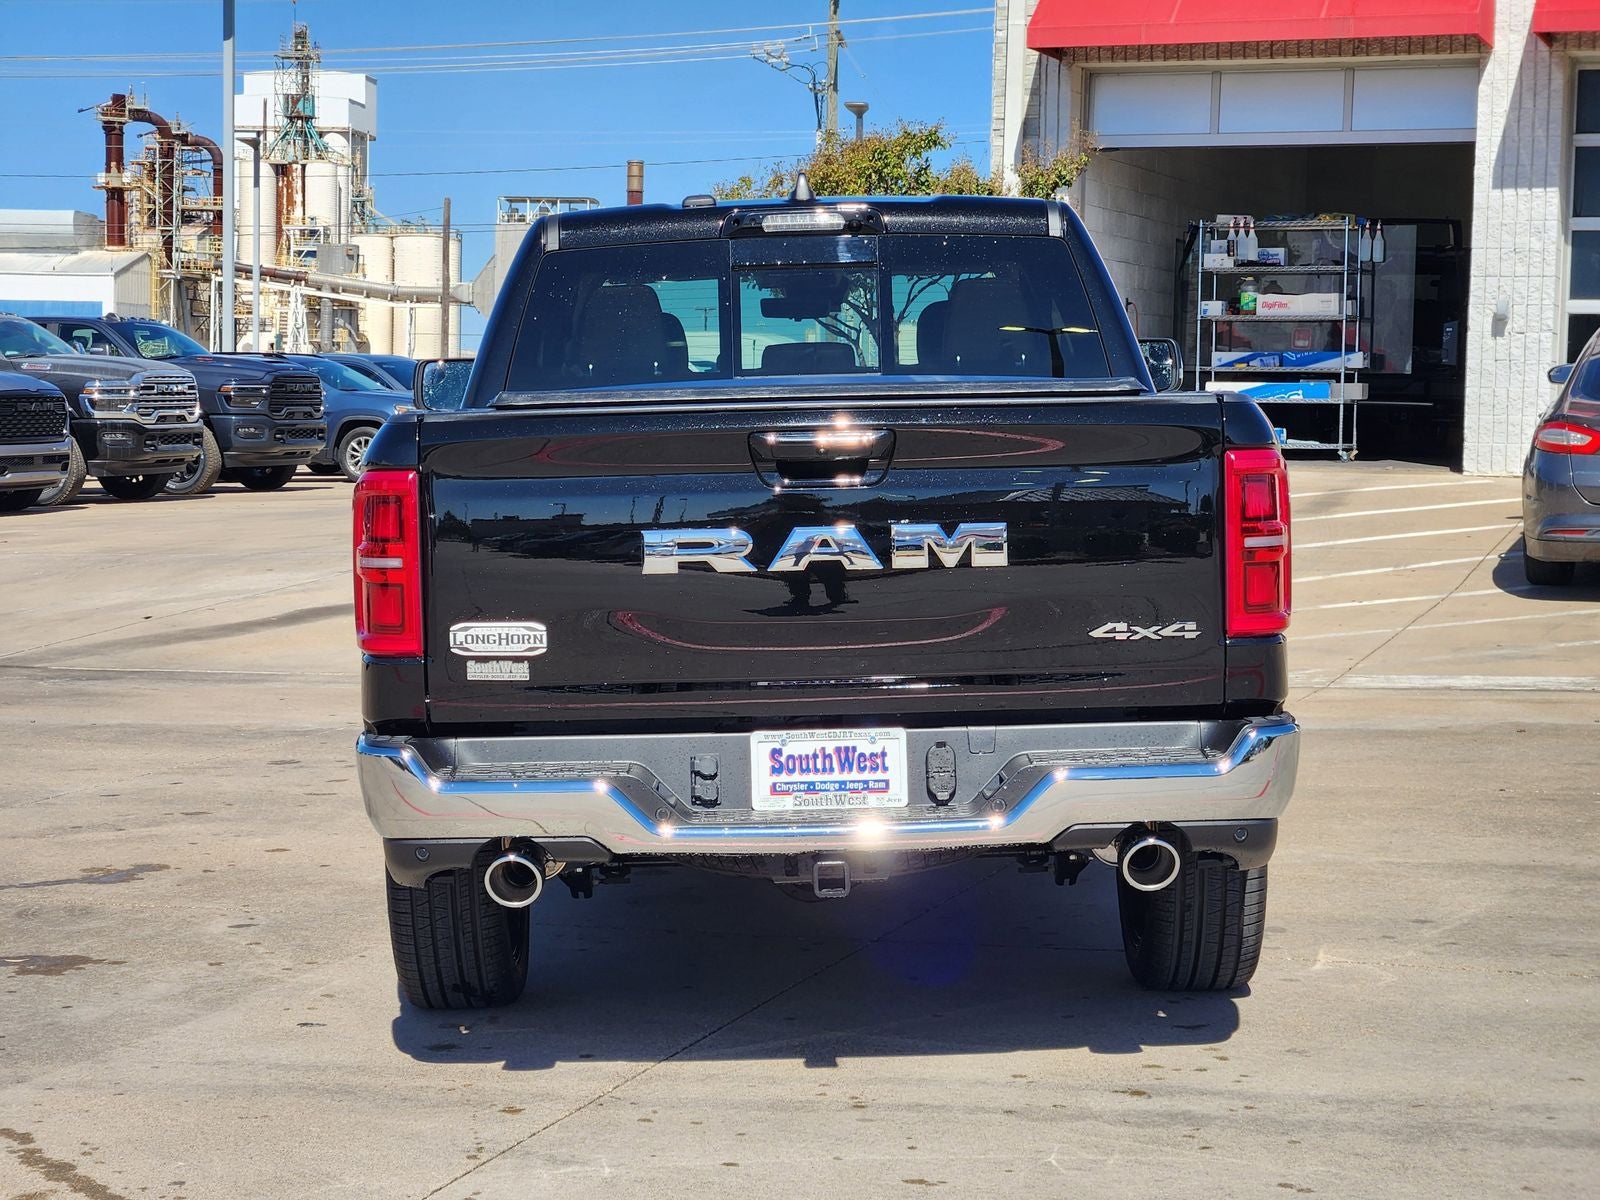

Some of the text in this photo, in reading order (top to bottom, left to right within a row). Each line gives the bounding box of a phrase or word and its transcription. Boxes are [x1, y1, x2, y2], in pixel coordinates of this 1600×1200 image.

[1261, 301, 1288, 310] DigiFilm
[286, 384, 314, 392] RAM
[16, 402, 54, 412] RAM
[641, 522, 1008, 574] RAM
[452, 632, 544, 646] LONGHORN
[466, 660, 529, 673] SouthWest
[769, 745, 889, 777] SouthWest
[775, 780, 886, 792] Chrysler Dodge Jeep Ram
[793, 794, 869, 807] SouthWest
